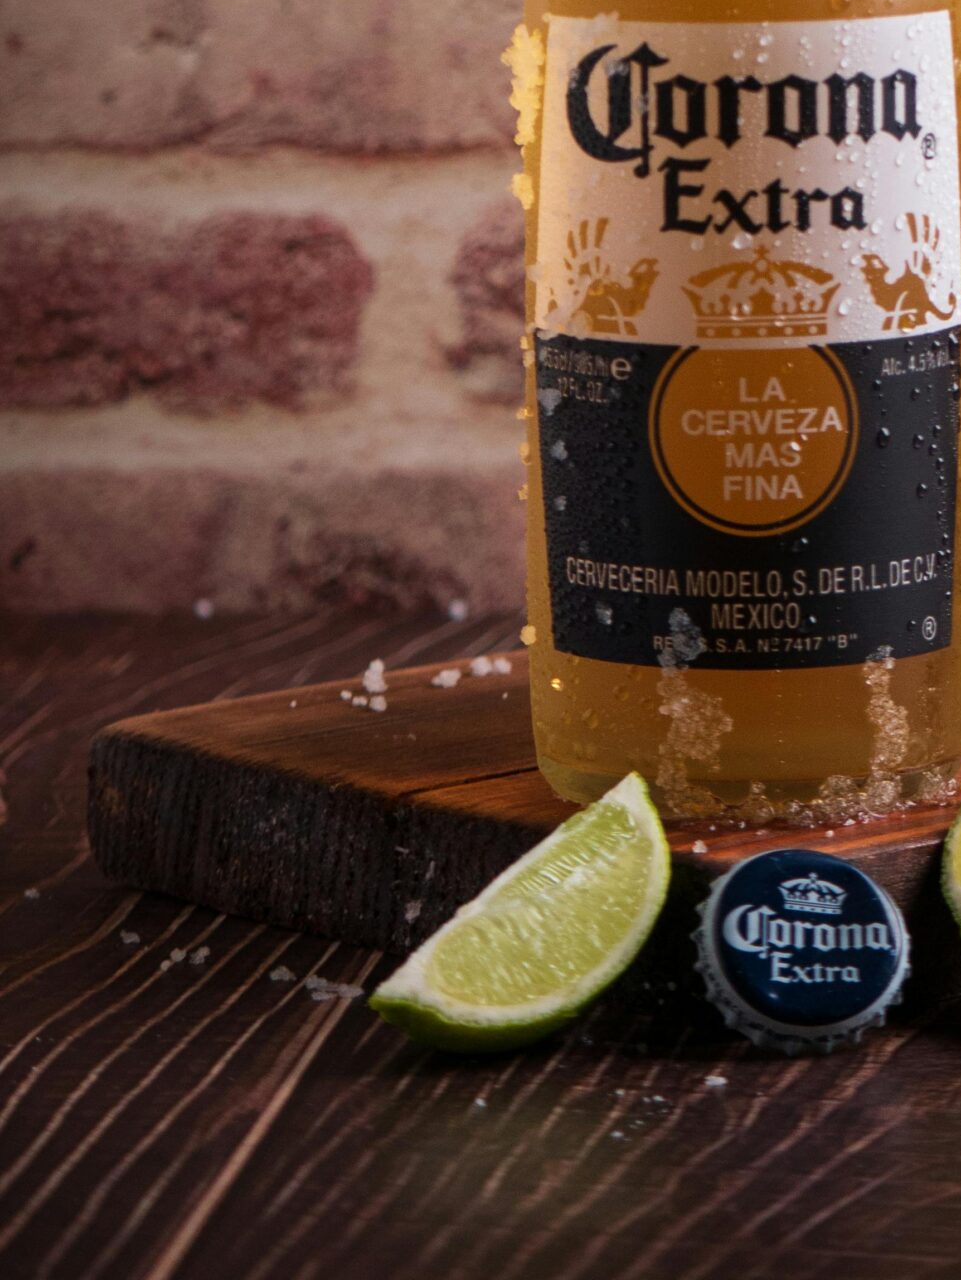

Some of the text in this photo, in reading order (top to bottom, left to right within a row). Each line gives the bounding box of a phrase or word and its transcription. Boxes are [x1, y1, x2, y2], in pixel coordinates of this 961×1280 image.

[566, 41, 922, 178] Corona
[658, 157, 867, 234] Extra
[738, 376, 787, 403] LA
[680, 406, 844, 435] CERVEZA
[725, 442, 801, 469] MAS
[723, 474, 805, 501] FINA
[566, 556, 680, 596] CERVECERIA
[686, 570, 788, 599] MODELO,
[819, 568, 846, 594] DE
[889, 558, 910, 587] DE
[711, 603, 800, 629] MEXICO
[784, 636, 823, 651] 7417
[723, 904, 892, 959] Corona
[770, 951, 860, 983] Extra
